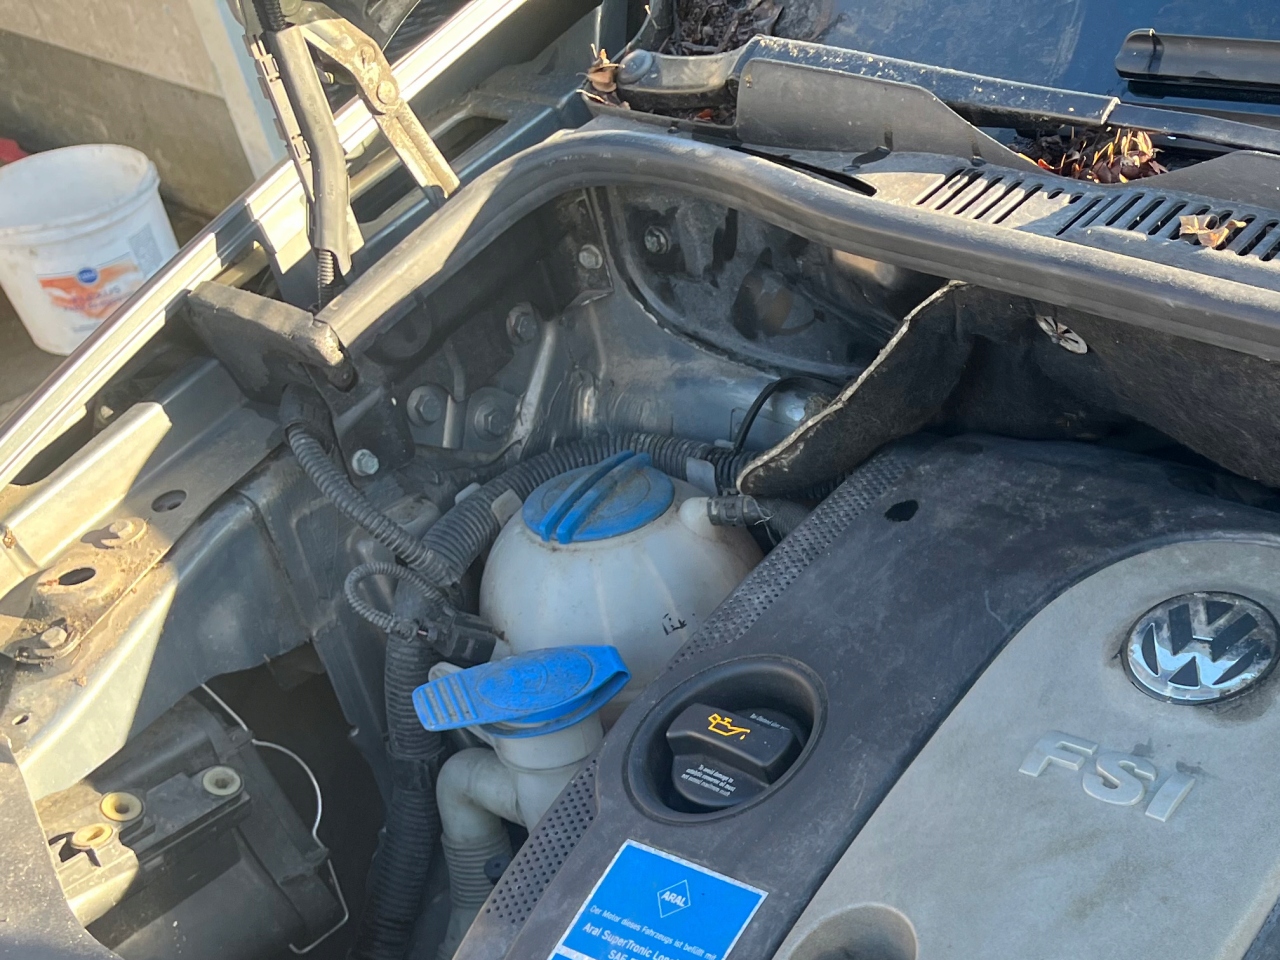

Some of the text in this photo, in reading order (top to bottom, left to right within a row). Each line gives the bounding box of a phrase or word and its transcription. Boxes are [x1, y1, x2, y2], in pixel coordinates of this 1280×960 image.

[1019, 730, 1195, 822] FSI
[661, 891, 686, 907] ARAL
[583, 922, 601, 935] Aral
[600, 929, 652, 959] SuperTronic
[589, 905, 716, 960] Der Motor dieses Fahrzeugs ist befüllt mit
